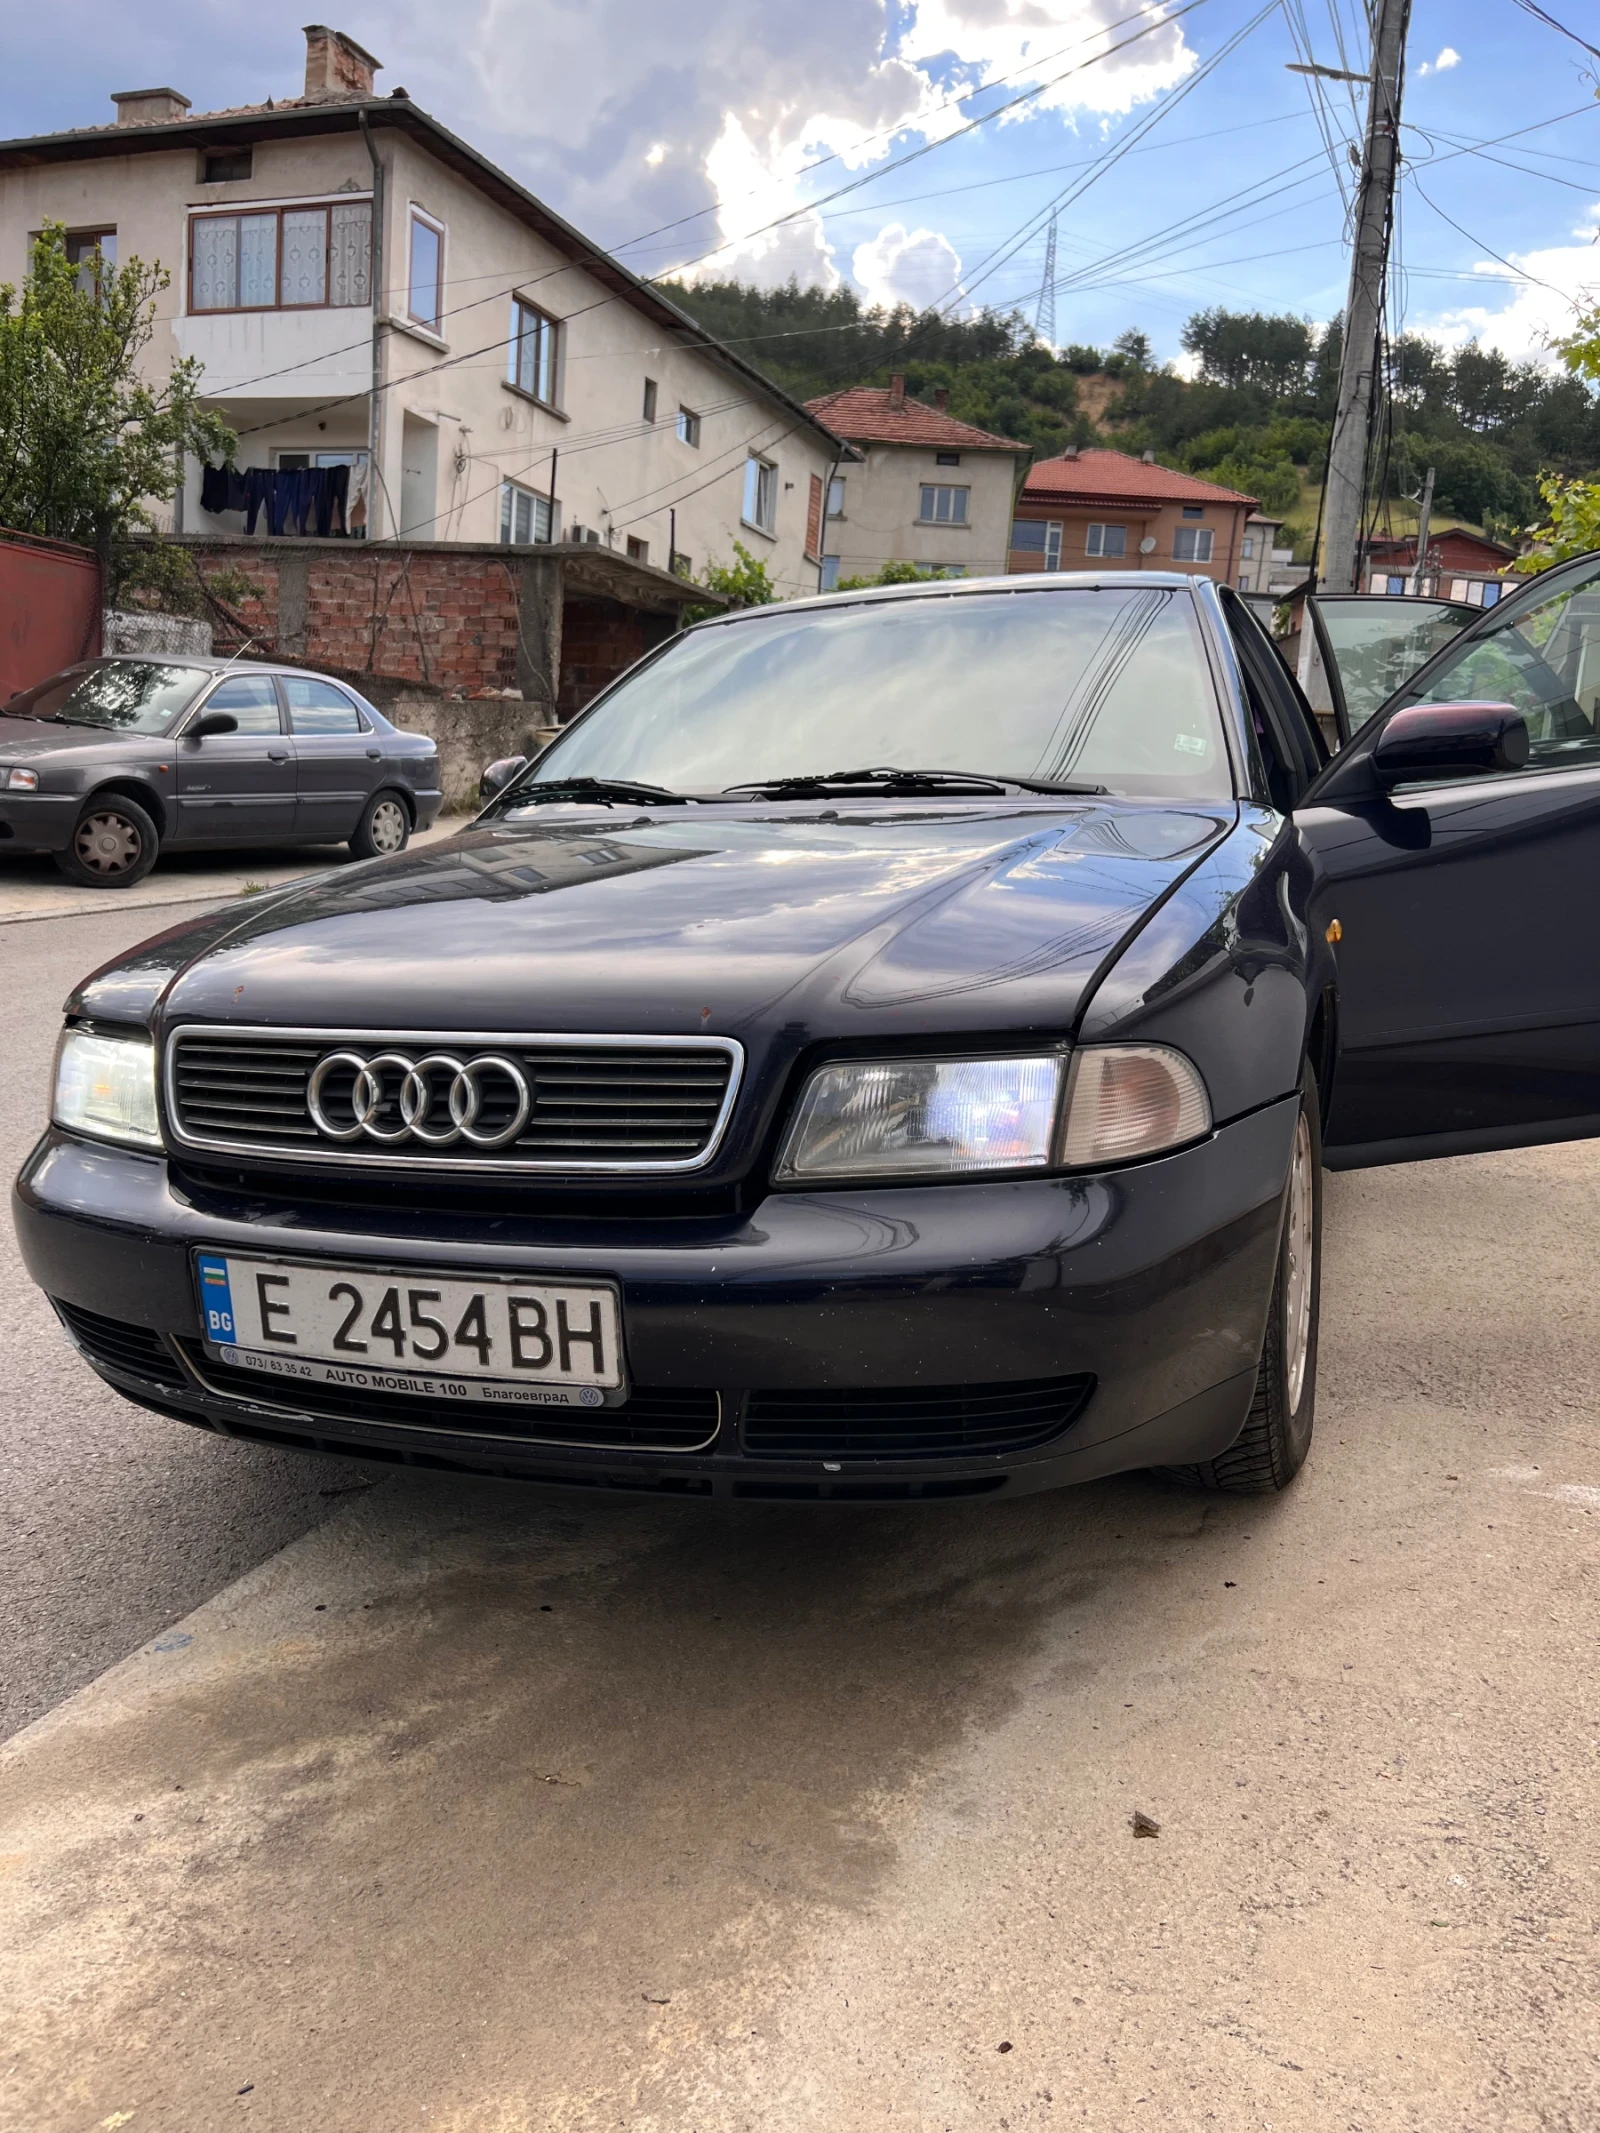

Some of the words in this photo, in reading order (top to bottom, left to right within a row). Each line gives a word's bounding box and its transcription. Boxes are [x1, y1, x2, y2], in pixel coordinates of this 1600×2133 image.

[208, 1309, 233, 1332] BG
[255, 1272, 298, 1345] E
[328, 1281, 493, 1366] 2454
[507, 1295, 605, 1375] BH
[271, 1362, 283, 1372] 83
[286, 1364, 297, 1374] 35
[300, 1366, 313, 1377] 42
[325, 1369, 368, 1386] AUTO
[372, 1376, 435, 1394] MOBILE
[439, 1383, 467, 1397] 100
[482, 1387, 570, 1404] Благоевград
